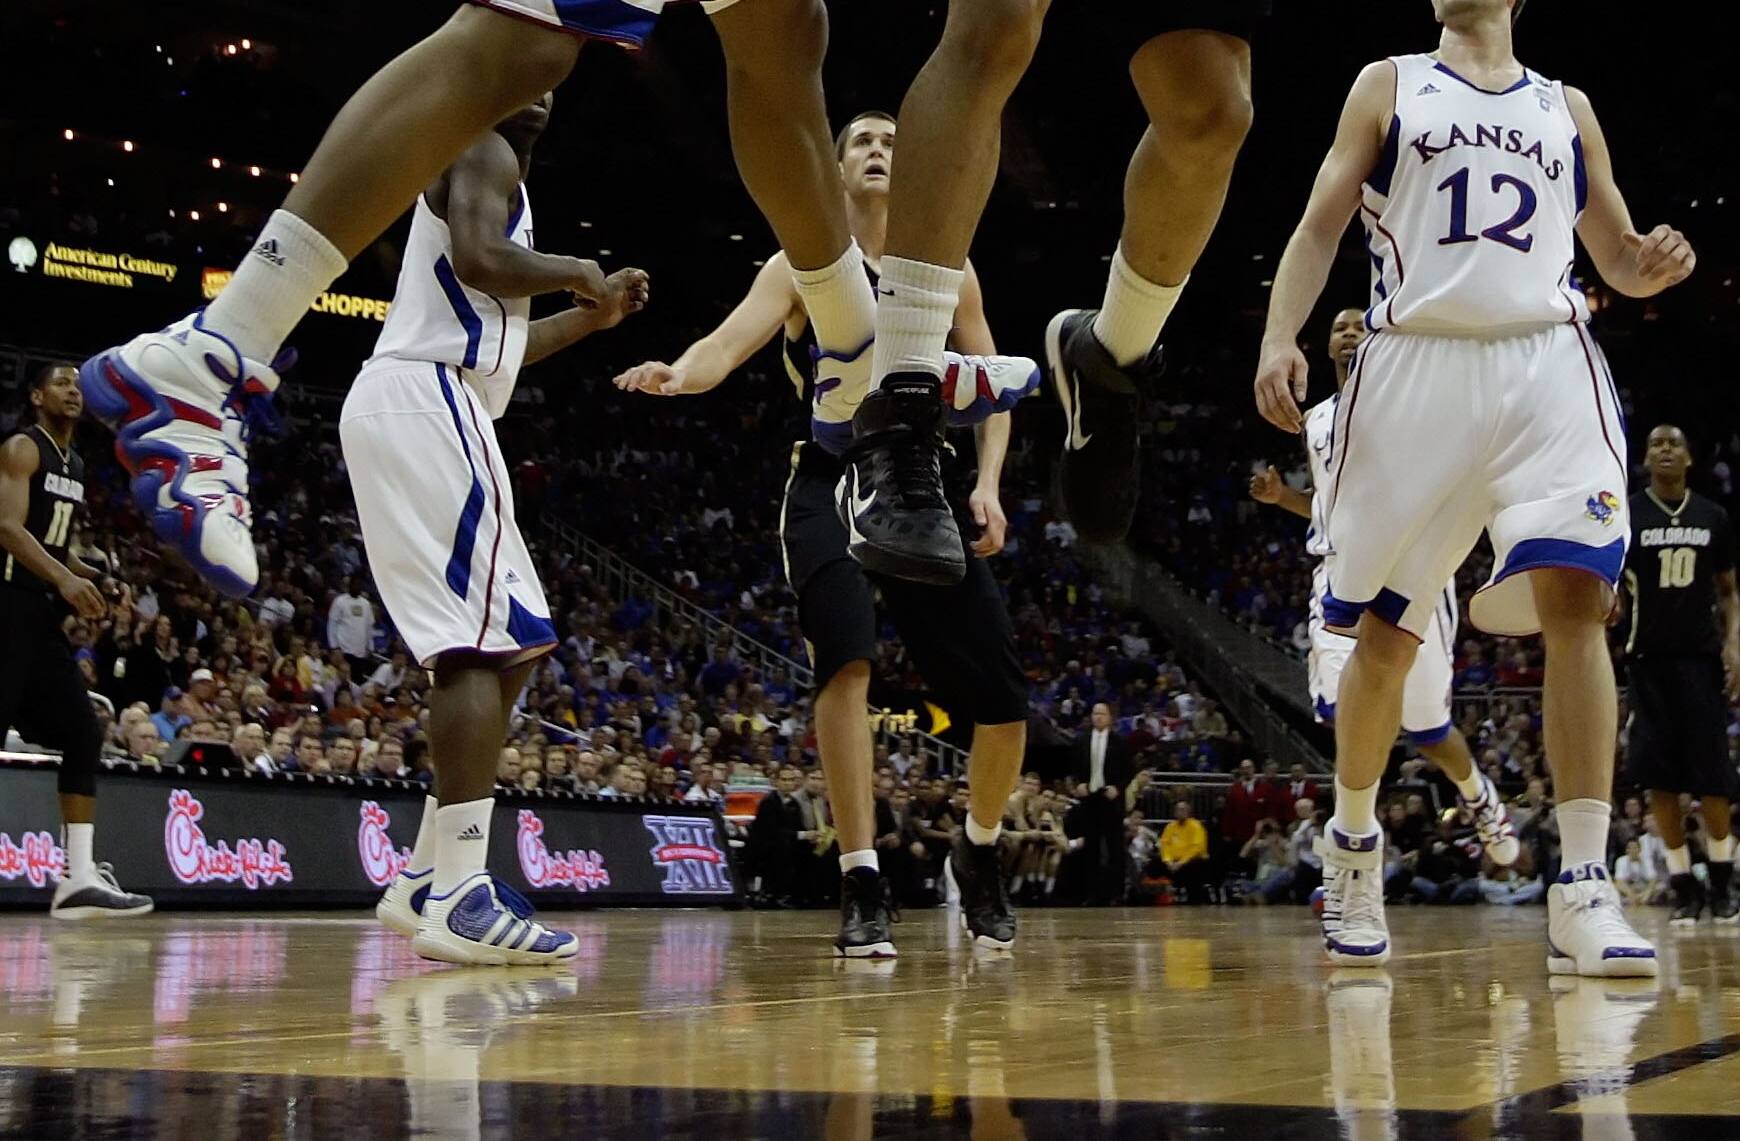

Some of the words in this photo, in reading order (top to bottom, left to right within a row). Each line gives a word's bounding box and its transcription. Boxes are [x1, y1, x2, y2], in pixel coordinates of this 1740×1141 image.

[1410, 123, 1564, 181] KANSAS
[1437, 166, 1537, 253] 12
[43, 258, 134, 288] Investments
[44, 241, 118, 269] American
[119, 253, 178, 283] Century
[311, 292, 391, 322] CHOPPE
[44, 500, 74, 548] 11
[1640, 526, 1711, 547] COLORADO
[1658, 547, 1697, 589] 10
